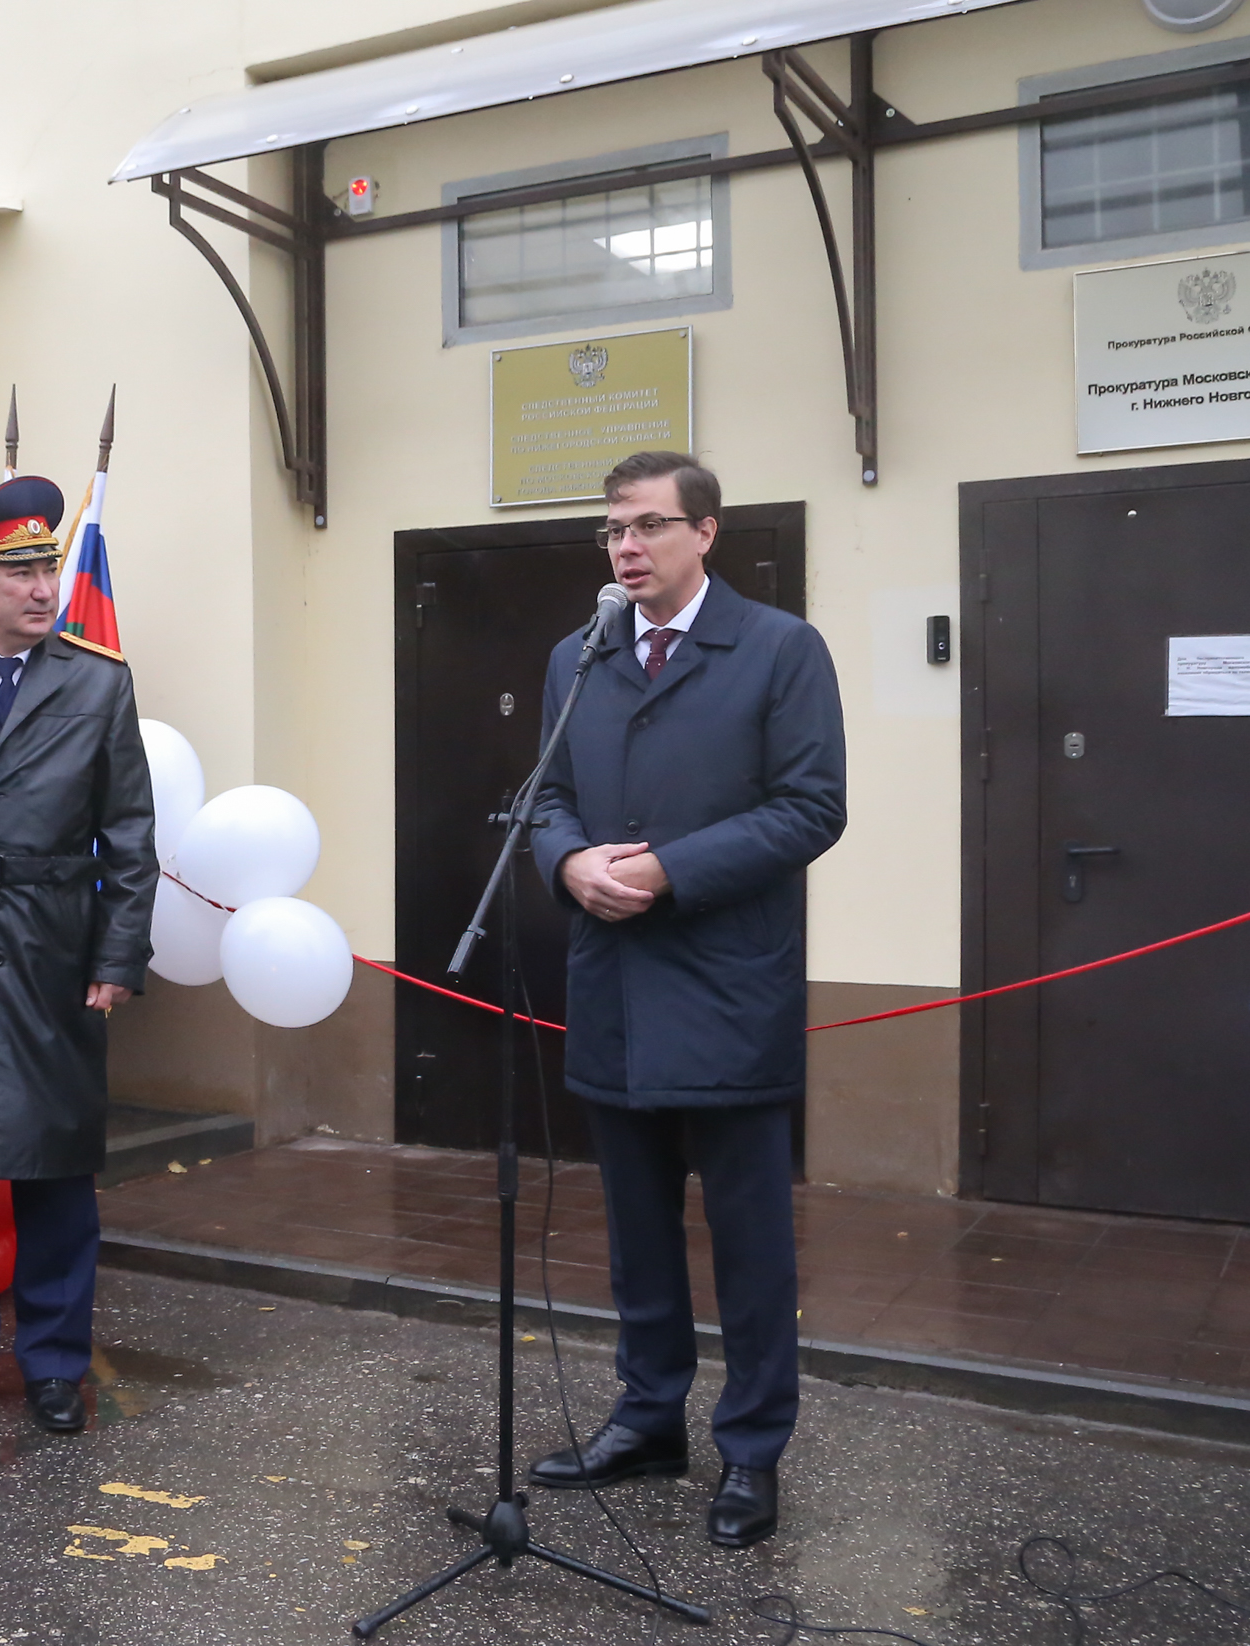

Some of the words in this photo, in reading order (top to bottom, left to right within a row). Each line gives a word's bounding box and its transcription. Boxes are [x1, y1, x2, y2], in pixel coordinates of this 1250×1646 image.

[1108, 336, 1176, 350] Прокуратура
[1179, 326, 1245, 342] Российской
[1088, 377, 1178, 396] Прокуратура
[521, 393, 606, 411] СЛЕДСТВЕННЫЙ
[609, 388, 659, 401] КОМИТЕТ
[521, 407, 592, 422] РОССИЙСКОЙ
[594, 399, 660, 414] ФЕДЕРАЦИИ
[1131, 402, 1139, 411] г.
[1143, 395, 1205, 410] Нижнего
[510, 427, 593, 443] СЛЕДСТВЕННОЕ
[601, 419, 671, 434] УПРАВЛЕНИЕ
[510, 446, 525, 454] ПО
[527, 436, 619, 453] НИЖЕГОРОДСКОЙ
[621, 430, 672, 443] ОБЛАСТИ
